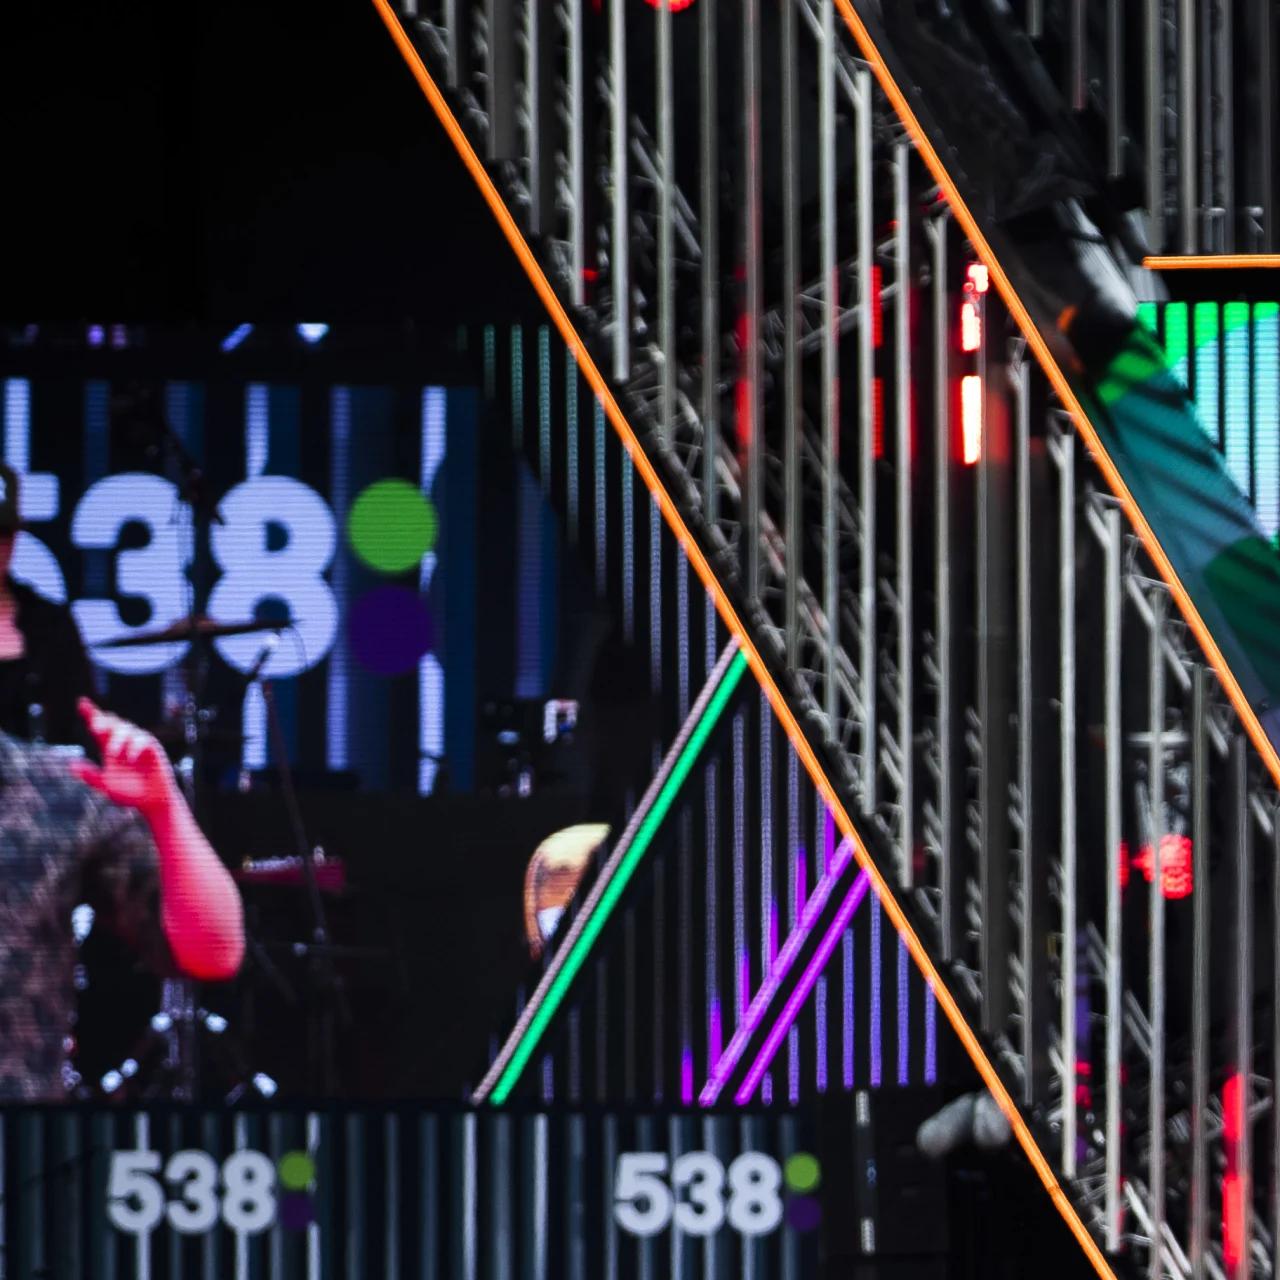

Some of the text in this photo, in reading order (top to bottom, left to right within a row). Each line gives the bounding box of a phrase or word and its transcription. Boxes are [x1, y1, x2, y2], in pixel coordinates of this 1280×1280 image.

[10, 472, 339, 679] 38
[108, 1150, 276, 1234] 538
[613, 1152, 784, 1235] 538
